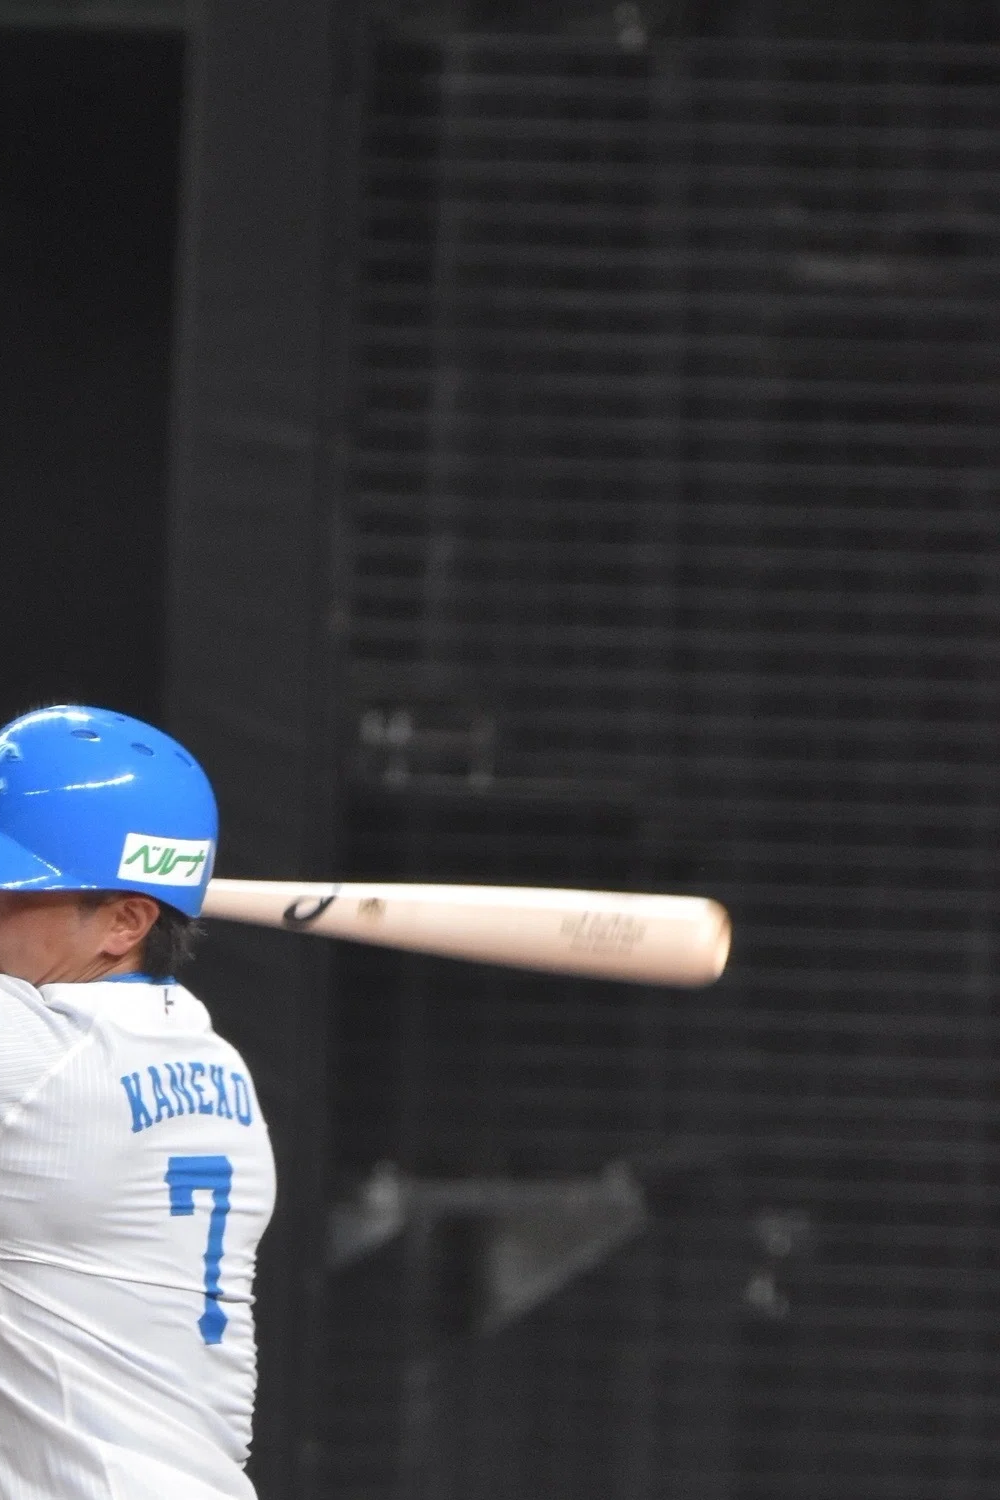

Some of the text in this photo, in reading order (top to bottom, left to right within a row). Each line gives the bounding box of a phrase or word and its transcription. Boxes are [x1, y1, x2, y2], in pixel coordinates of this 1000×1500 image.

[124, 845, 206, 877] ベルーナ
[120, 1061, 253, 1133] KANEKO
[164, 1155, 233, 1345] 7
